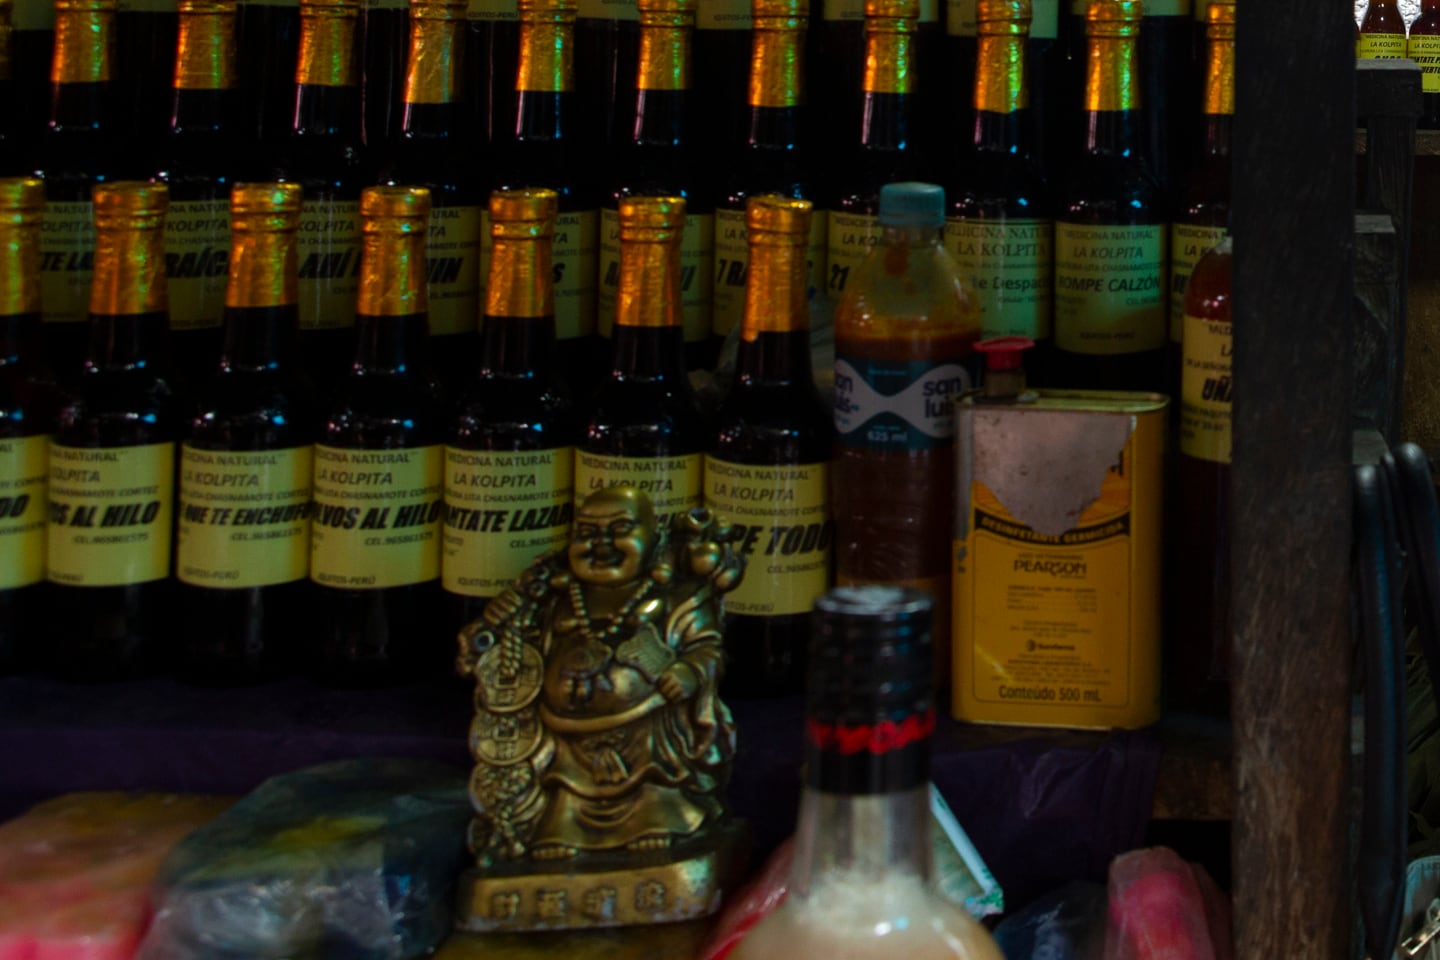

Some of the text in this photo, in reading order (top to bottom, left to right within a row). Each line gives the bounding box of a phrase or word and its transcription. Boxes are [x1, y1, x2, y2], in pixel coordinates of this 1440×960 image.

[1091, 248, 1143, 258] KOLPITA
[923, 378, 960, 396] san
[196, 472, 259, 486] KOLPITA
[330, 471, 393, 484] KOLPITA
[470, 475, 536, 488] KOLPITA
[731, 485, 793, 501] KOLPITA
[71, 501, 160, 527] AL HILO
[361, 501, 440, 529] AL HILO
